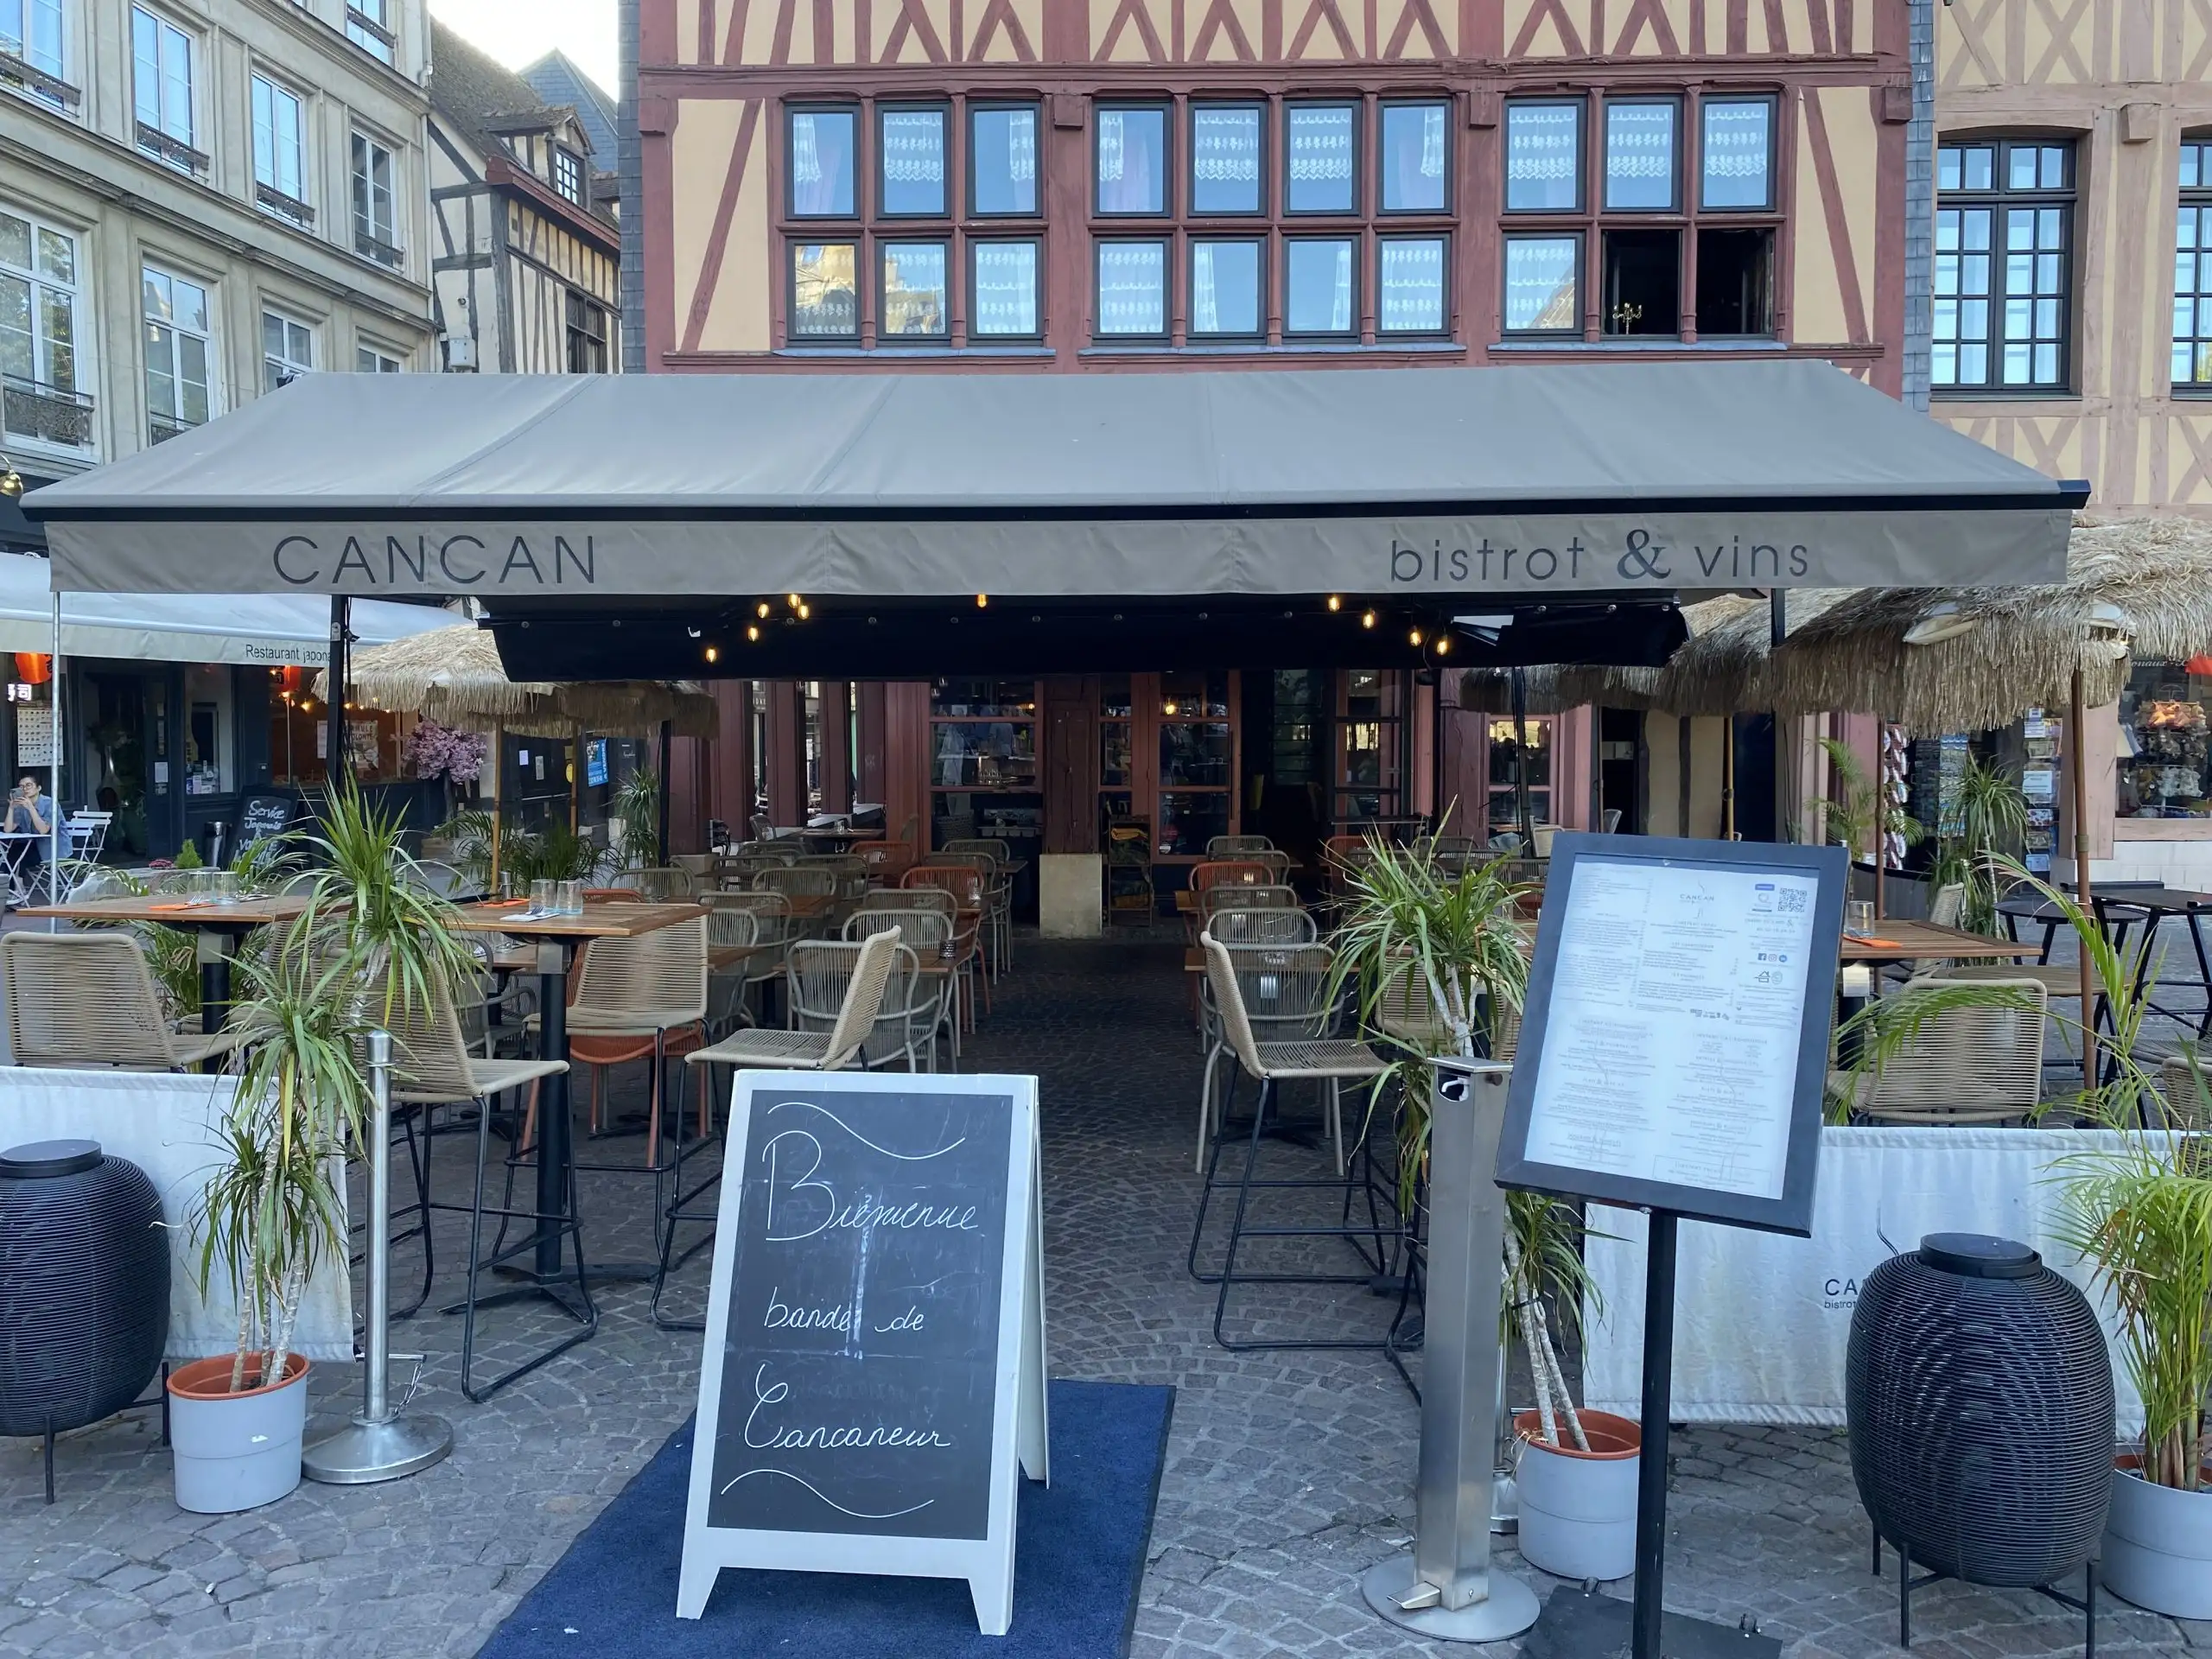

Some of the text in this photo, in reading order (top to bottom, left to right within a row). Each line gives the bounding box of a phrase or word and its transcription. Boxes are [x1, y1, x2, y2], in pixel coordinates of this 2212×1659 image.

[273, 535, 595, 584] CANCAN
[1390, 529, 1809, 582] bistrot & vins
[245, 645, 300, 660] Restaurant
[248, 800, 285, 819] Service
[874, 1305, 925, 1332] de
[745, 1363, 951, 1448] Cancaneur
